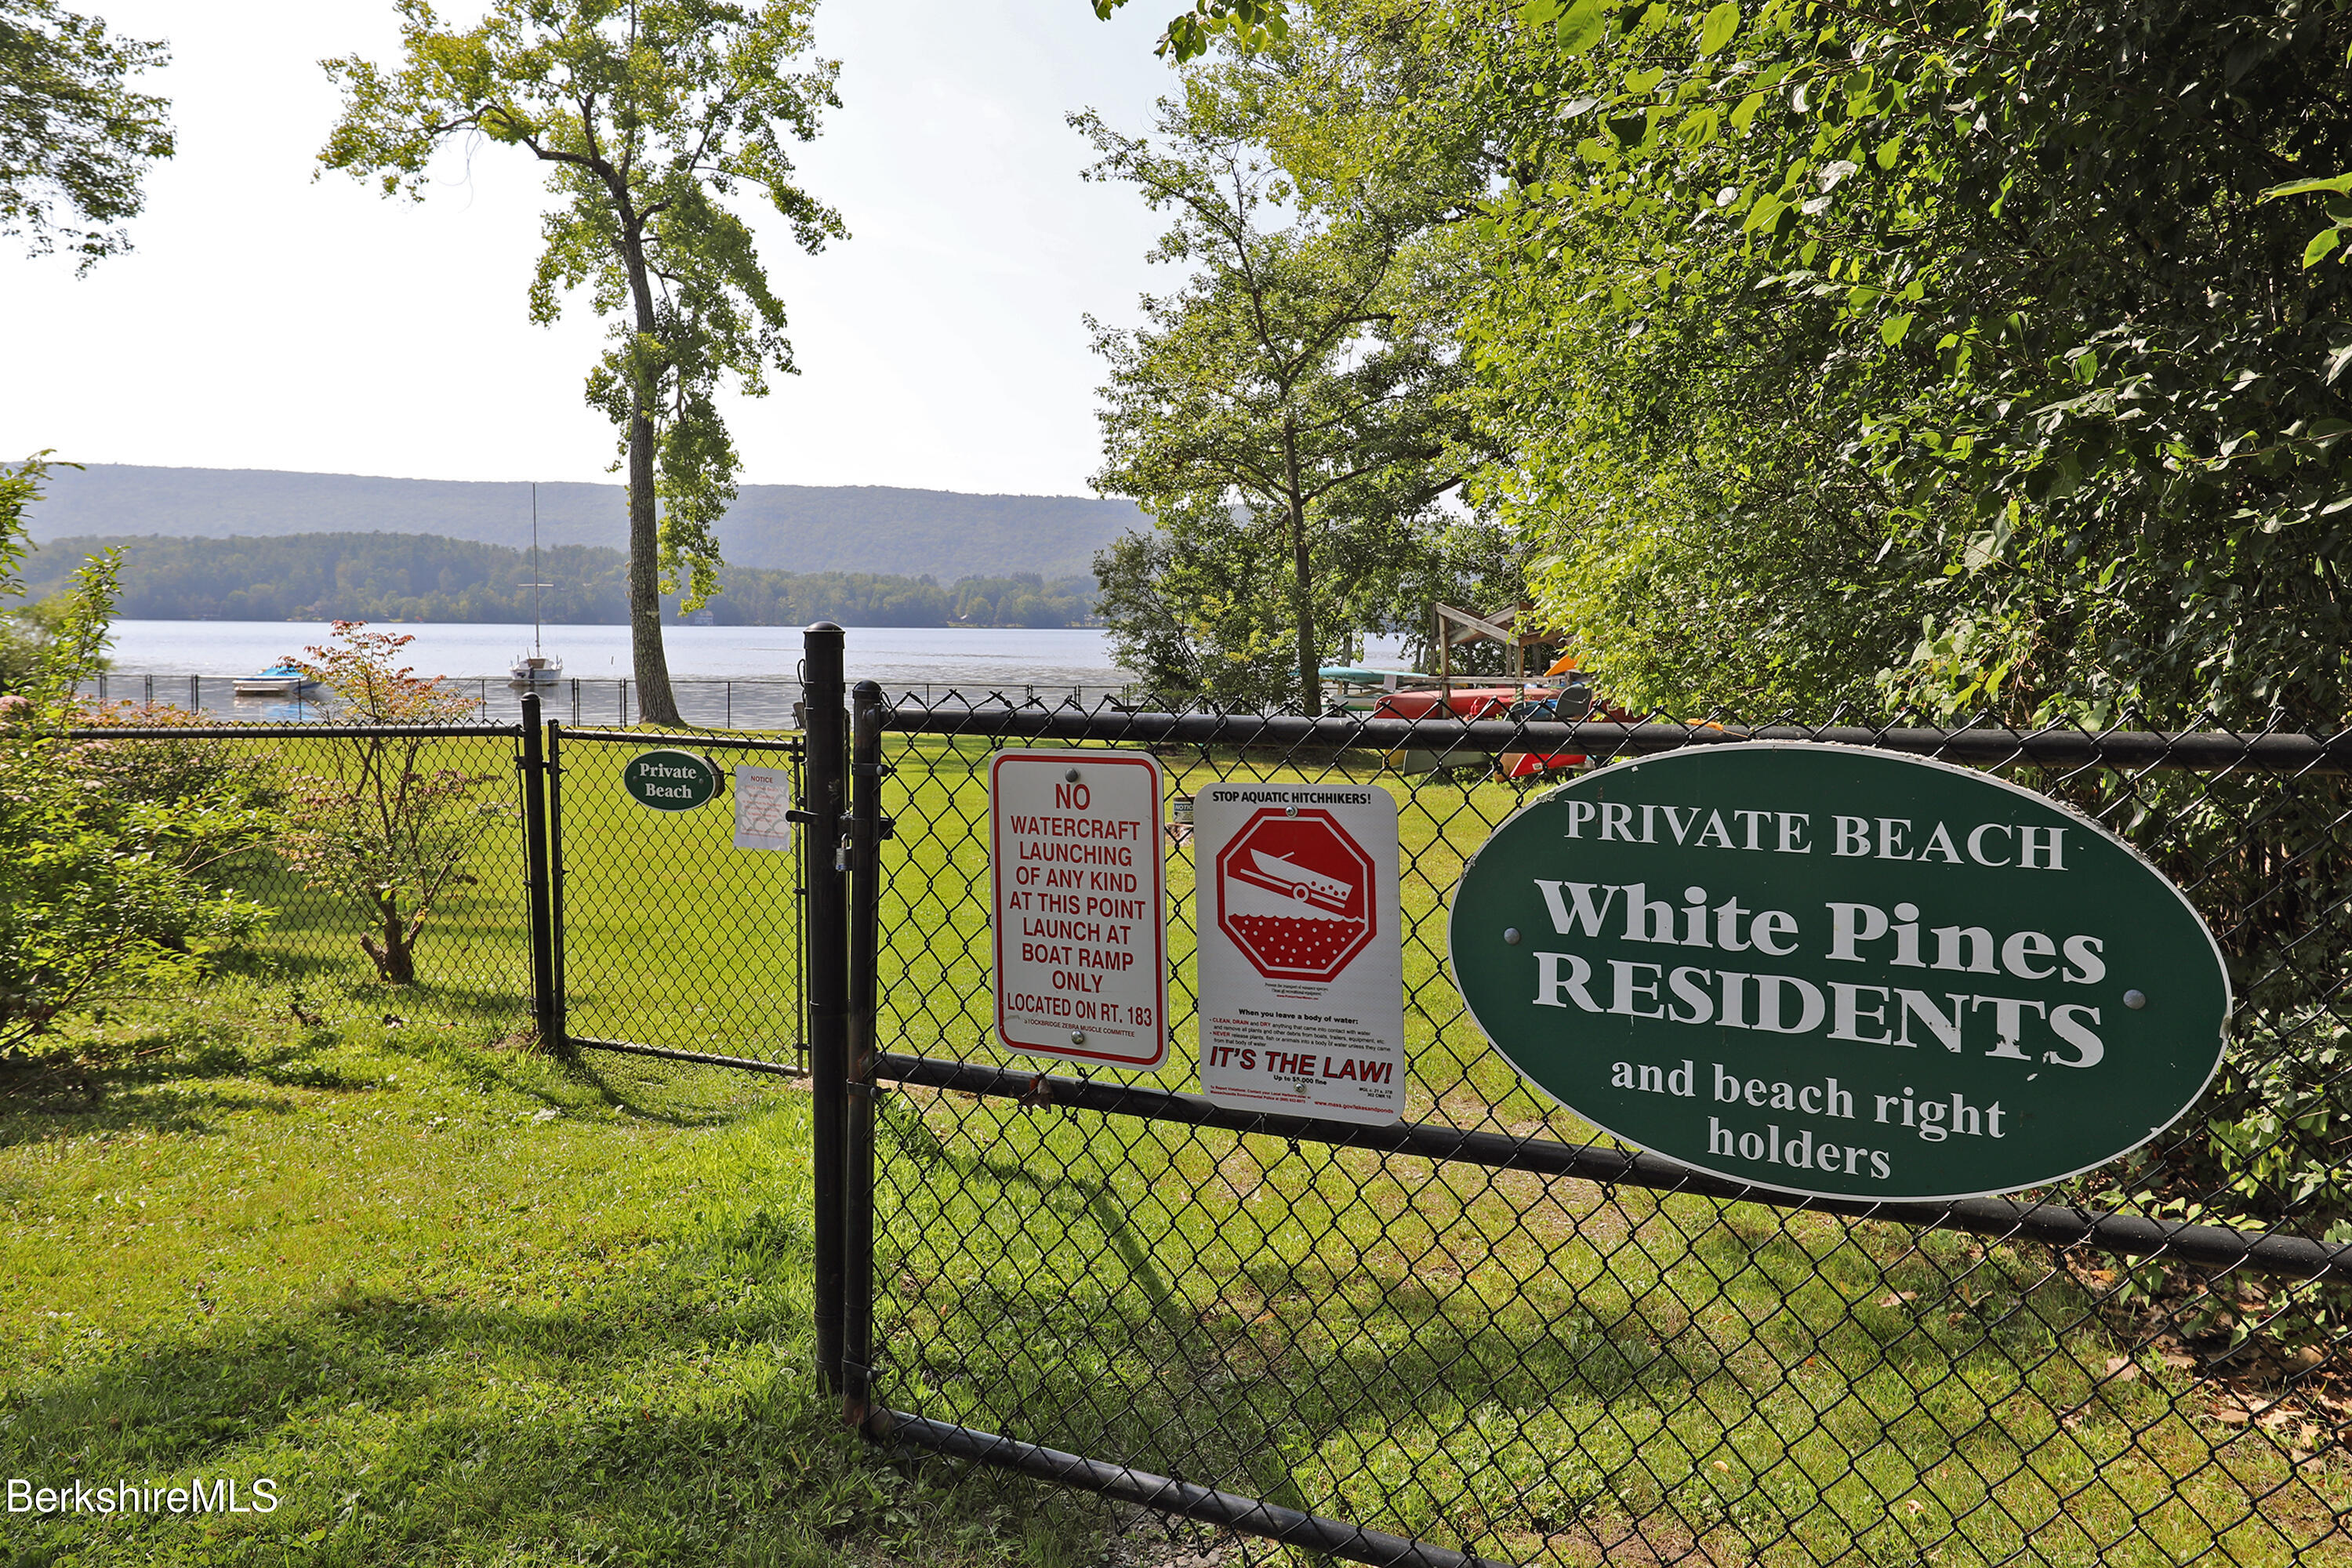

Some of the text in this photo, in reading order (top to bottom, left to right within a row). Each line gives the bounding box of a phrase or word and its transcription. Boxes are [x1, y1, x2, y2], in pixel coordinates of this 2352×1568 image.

[640, 763, 696, 779] Private
[750, 775, 773, 784] NOTICE
[645, 783, 693, 799] Beach
[1056, 783, 1091, 810] NO
[1213, 791, 1371, 804] STOP AQUATIC HITCHHIKERS!
[1011, 815, 1141, 840] WATERCRAFT
[1564, 800, 2070, 871] PRIVATE BEACH
[1020, 841, 1132, 866] LAUNCHING
[1016, 866, 1137, 893] OF ANY KIND
[1010, 891, 1145, 920] AT THIS POINT
[1023, 917, 1131, 945] LAUNCH AT
[1534, 879, 2106, 985] White Pines
[1022, 942, 1134, 971] BOAT RAMP
[1052, 970, 1103, 993] ONLY
[1007, 993, 1152, 1027] LOCATED ON RT. 183
[1533, 952, 2104, 1068] RESIDENTS
[1024, 1019, 1061, 1028] STOCKBRIDGE
[1080, 1025, 1102, 1033] MUSCLE
[1103, 1028, 1135, 1037] COMMITTEE
[1210, 1047, 1393, 1084] IT'S THE LAW!
[1611, 1058, 2006, 1142] and beach right
[1708, 1116, 1891, 1179] holders
